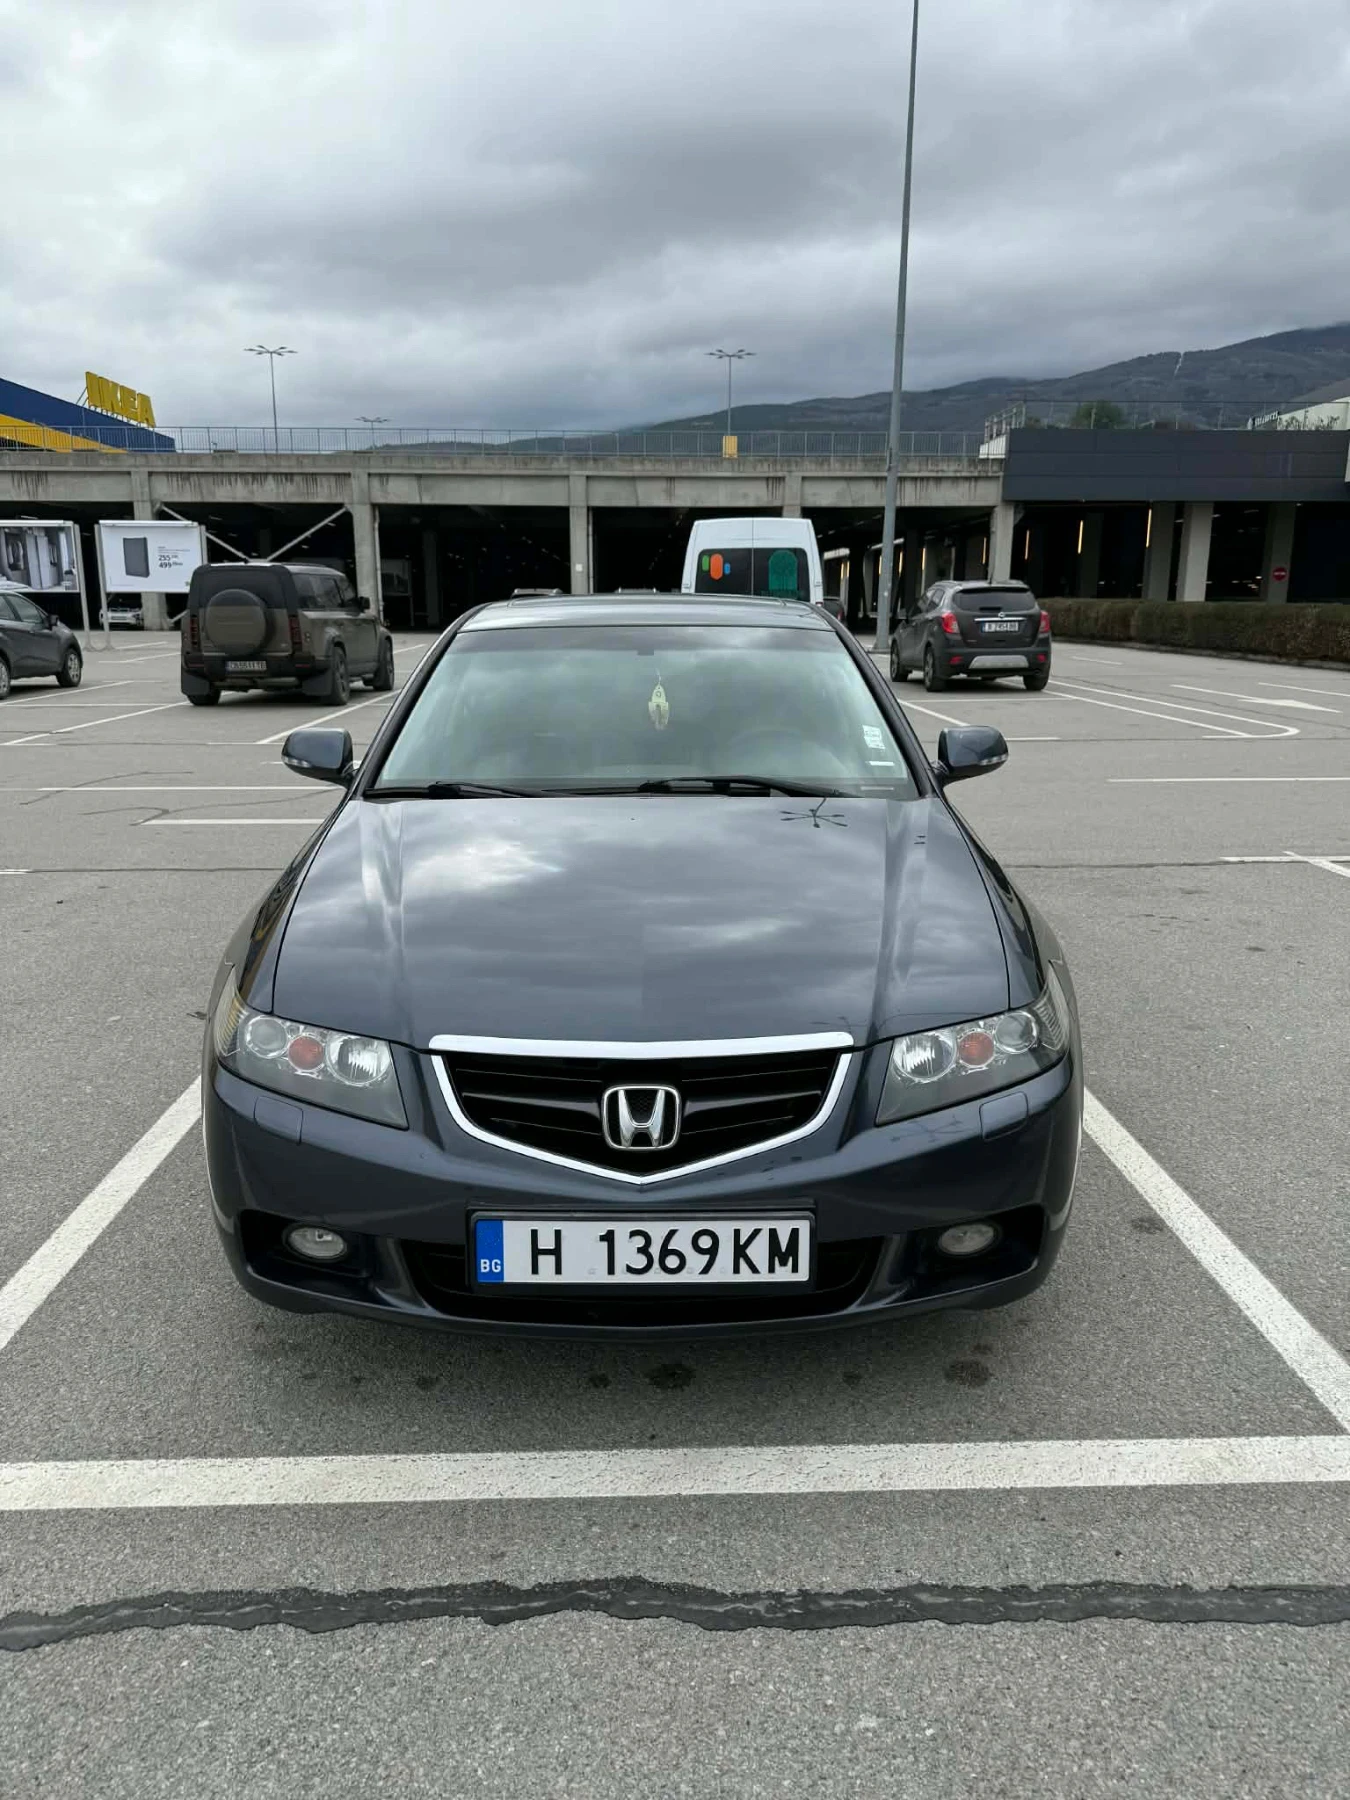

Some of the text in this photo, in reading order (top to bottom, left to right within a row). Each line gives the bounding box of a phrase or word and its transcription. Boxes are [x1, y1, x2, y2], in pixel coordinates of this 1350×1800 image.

[85, 371, 156, 427] IKEA
[480, 1259, 501, 1272] BG
[530, 1229, 562, 1275] H
